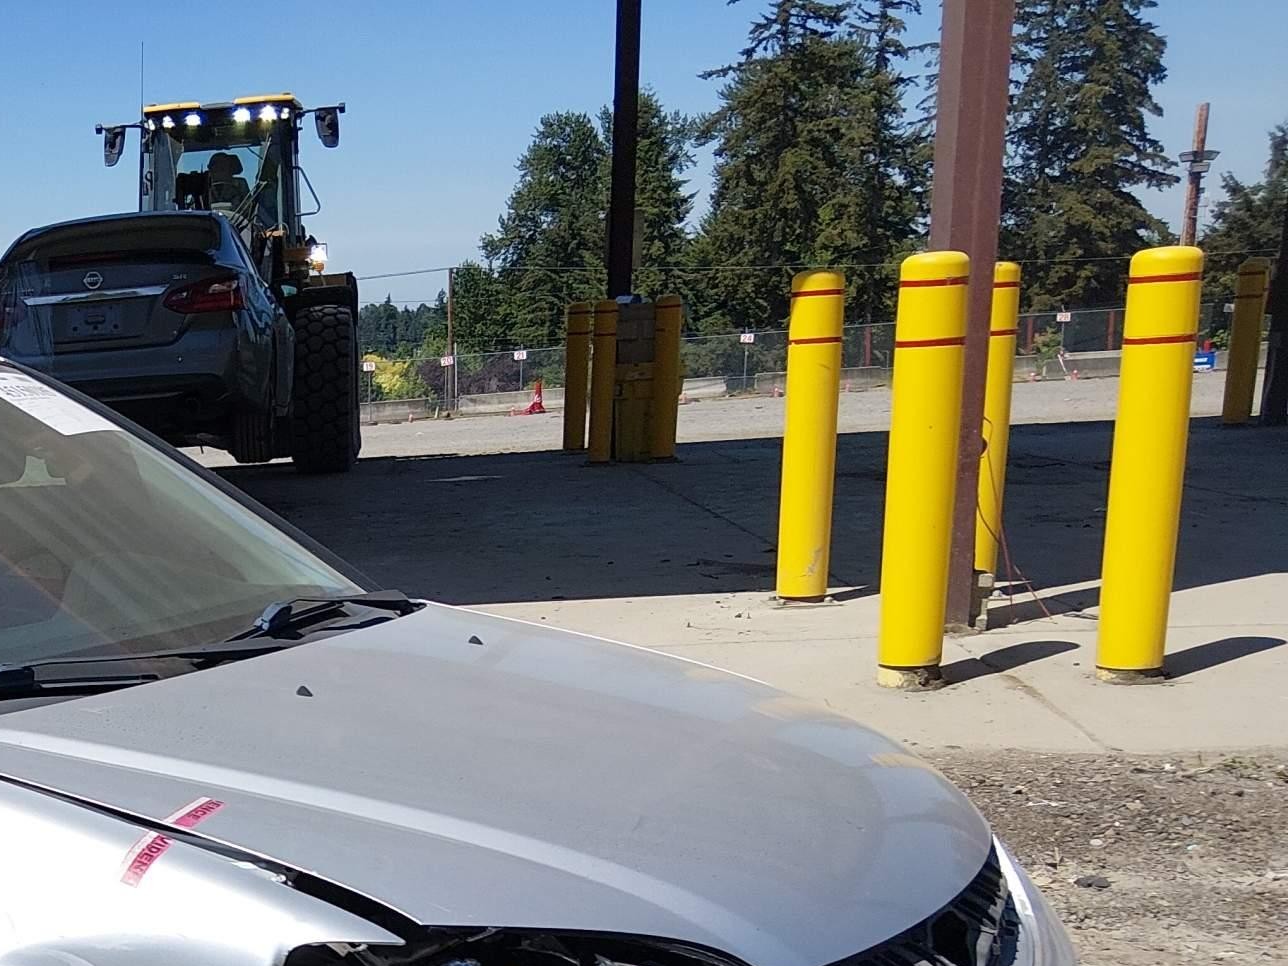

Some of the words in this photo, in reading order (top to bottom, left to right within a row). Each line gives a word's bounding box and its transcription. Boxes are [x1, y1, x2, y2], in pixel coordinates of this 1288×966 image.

[741, 334, 754, 342] 24
[515, 351, 526, 359] 21
[441, 357, 453, 366] 20
[365, 362, 375, 370] 19
